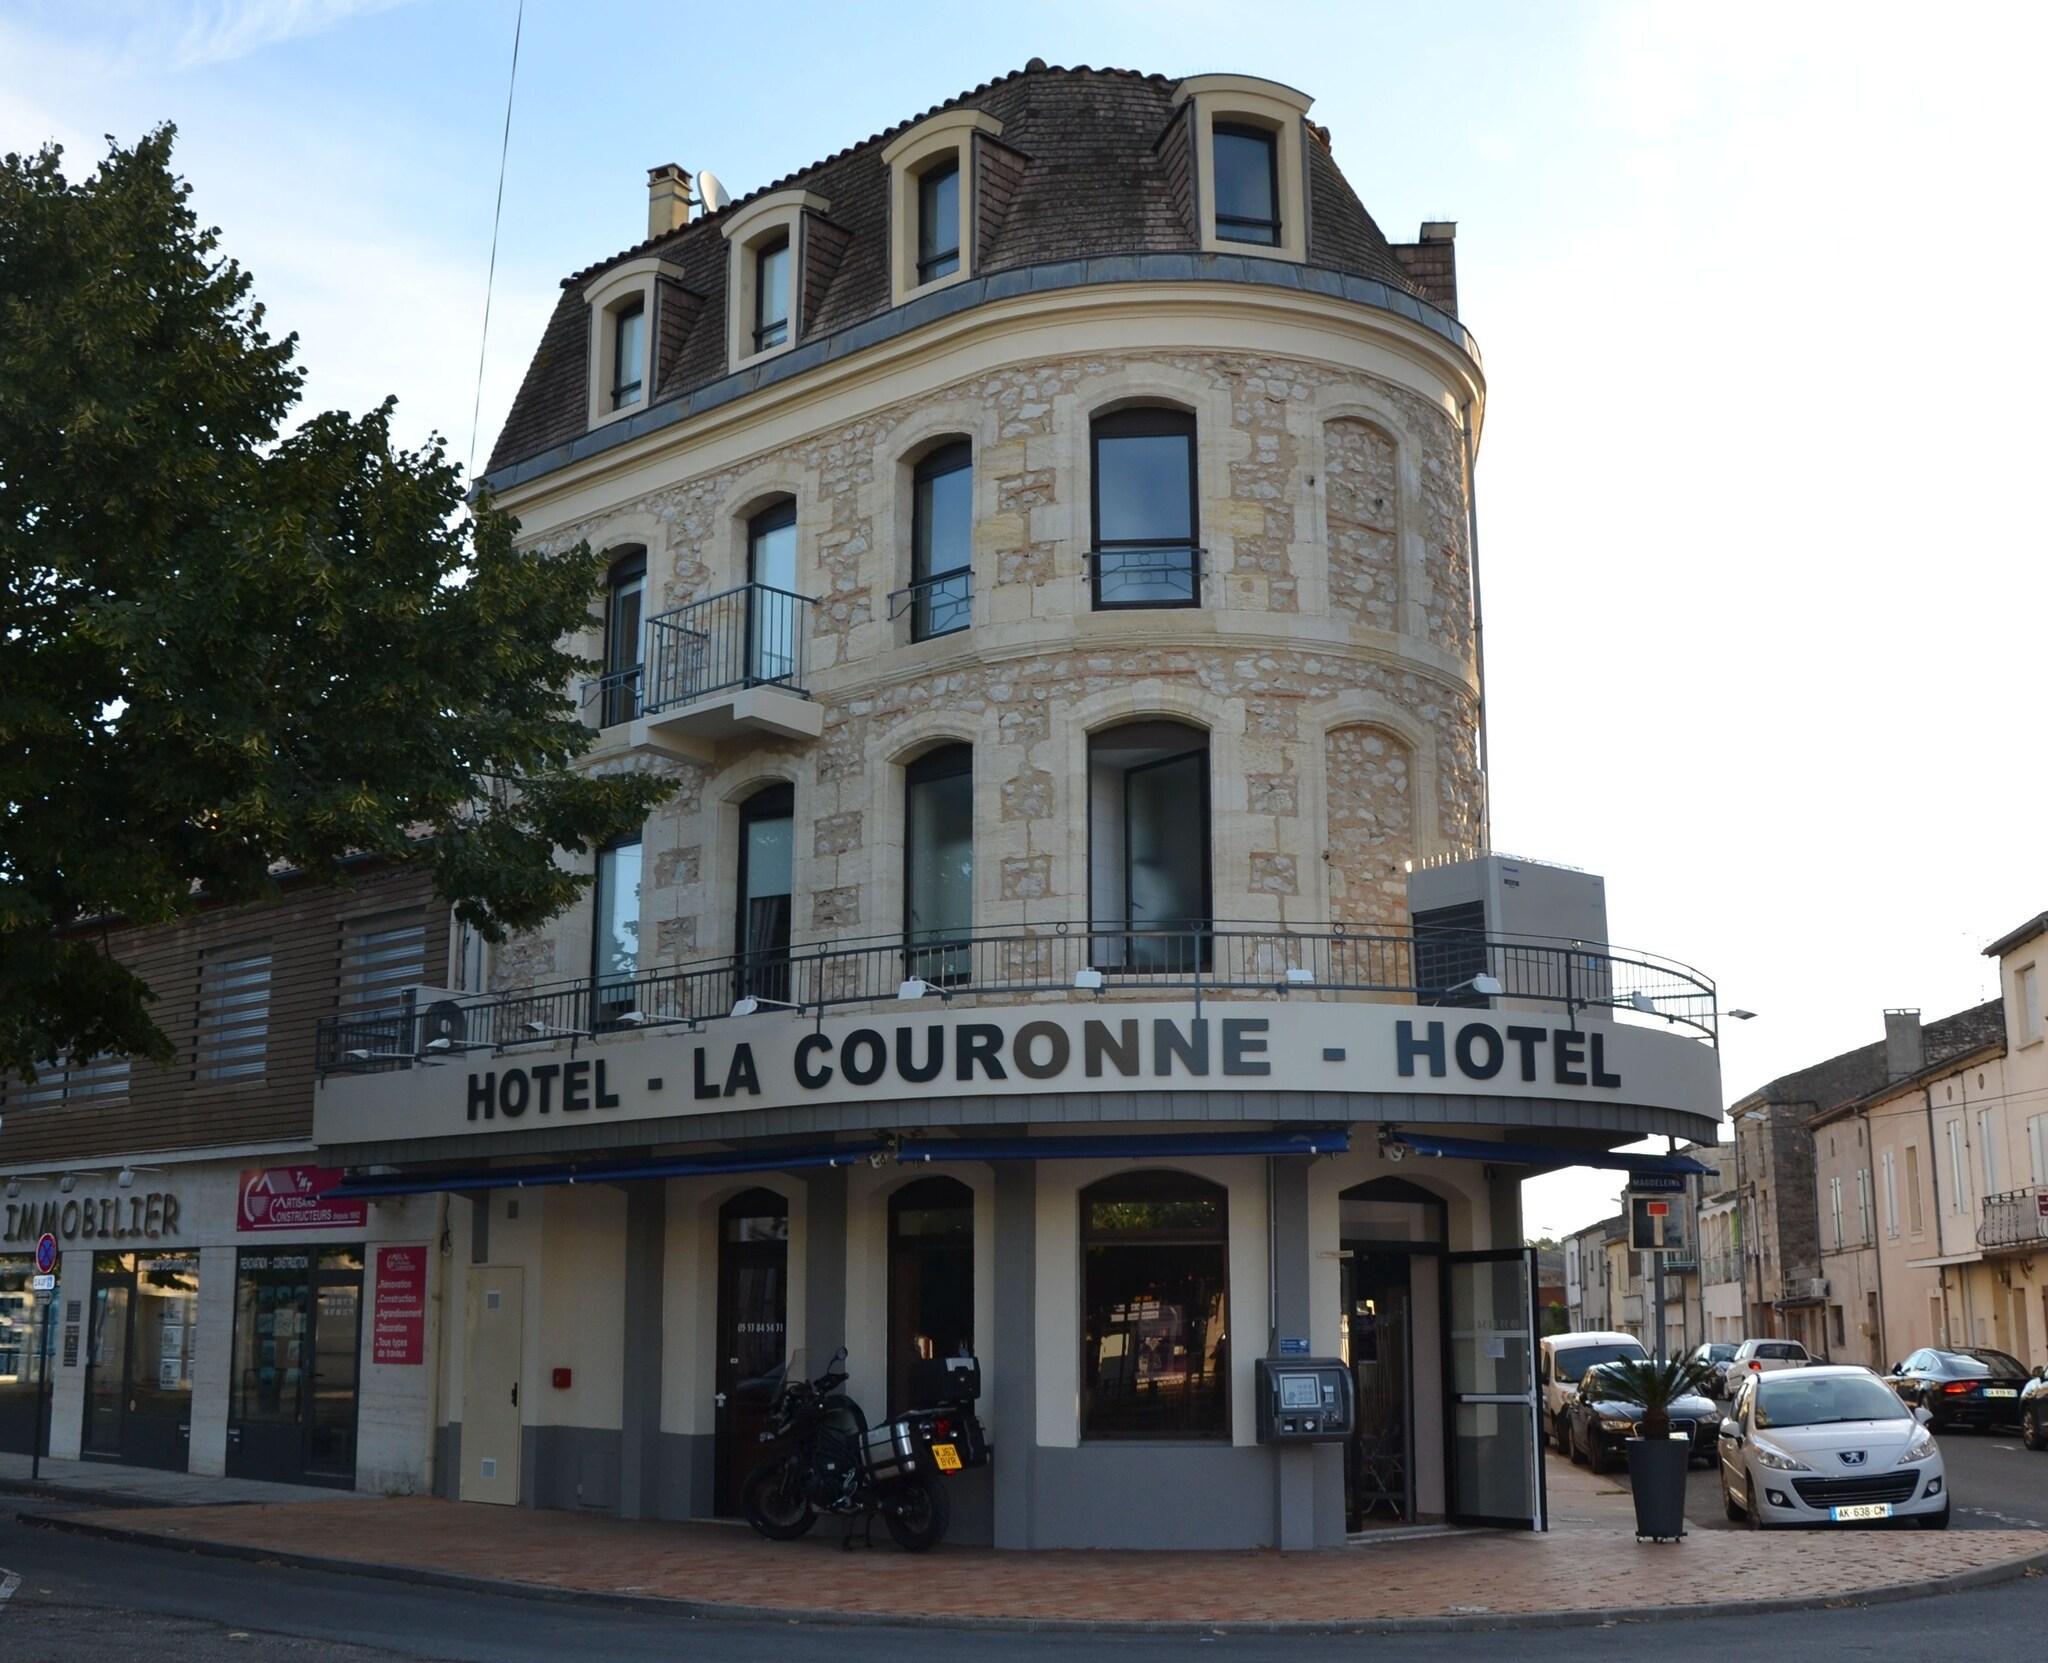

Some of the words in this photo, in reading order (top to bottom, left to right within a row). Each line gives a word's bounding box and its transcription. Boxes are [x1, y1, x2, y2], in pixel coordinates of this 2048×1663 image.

[466, 1057, 619, 1121] HOTEL
[693, 1042, 761, 1100] LA
[794, 1018, 1271, 1090] COURONNE
[1396, 1020, 1621, 1089] HOTEL
[3, 1192, 180, 1242] IMMOBILIER
